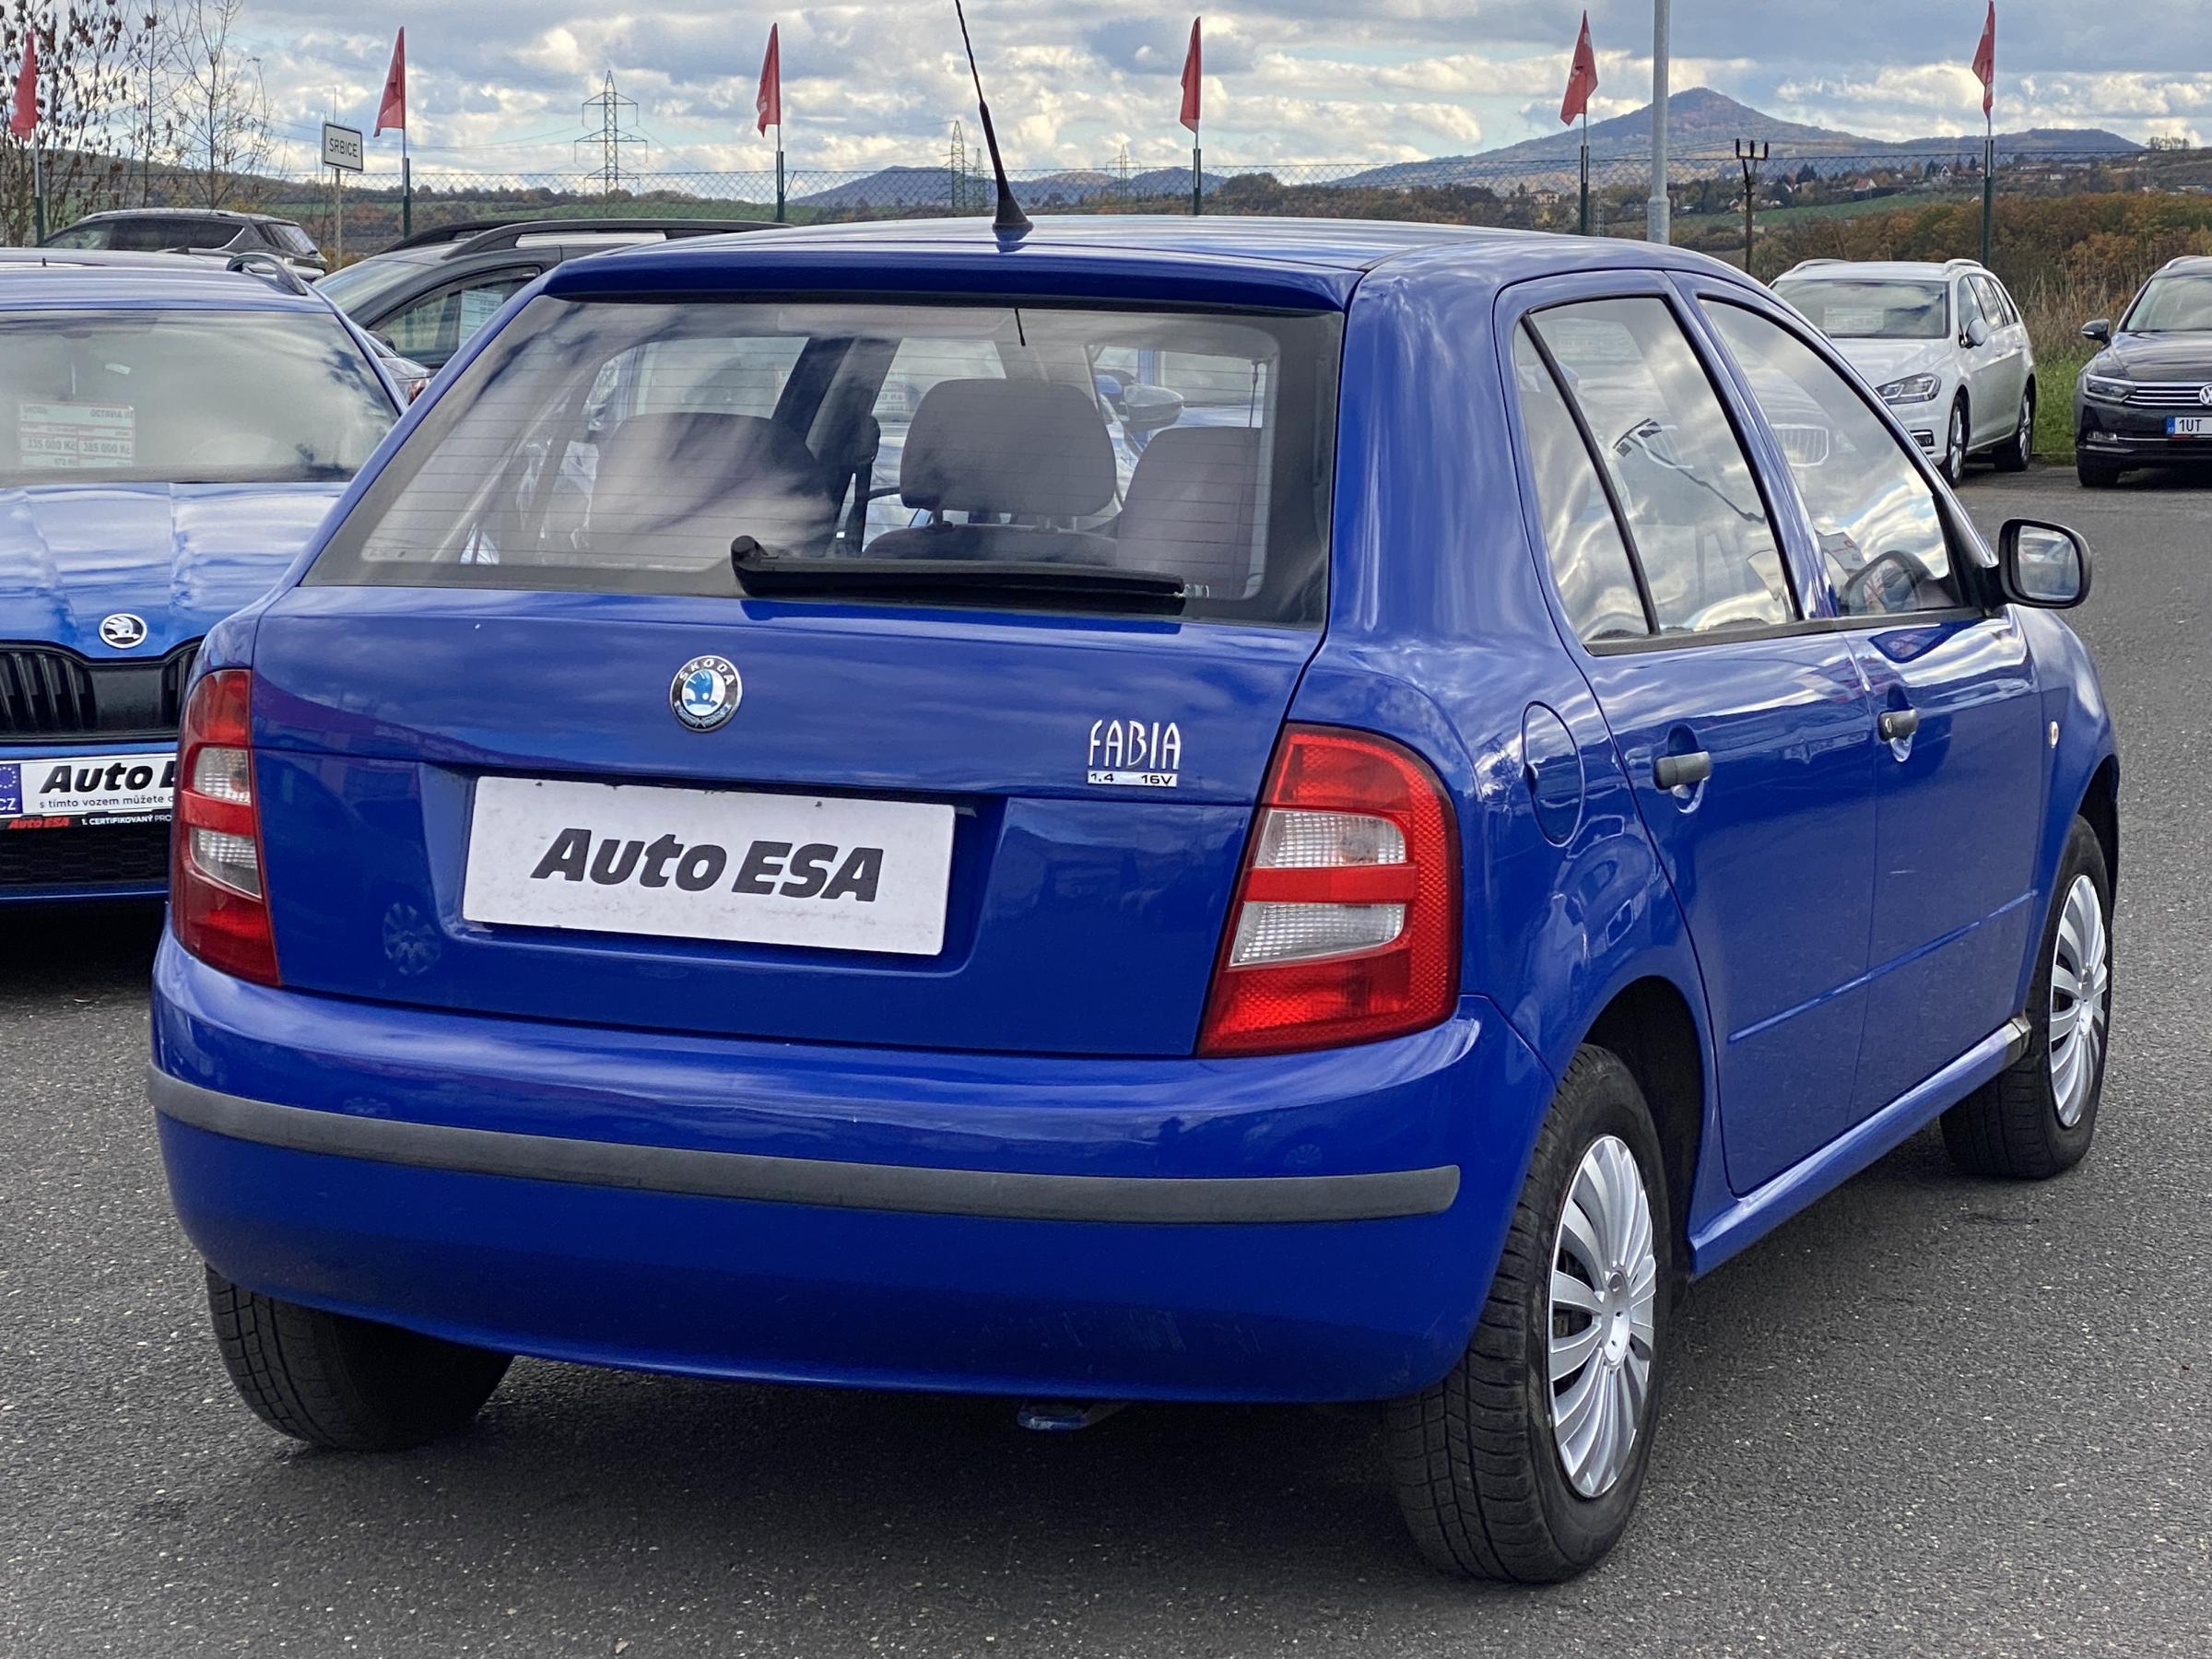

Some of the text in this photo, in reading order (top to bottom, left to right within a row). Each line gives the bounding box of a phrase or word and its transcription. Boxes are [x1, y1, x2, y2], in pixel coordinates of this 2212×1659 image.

[329, 137, 359, 158] SRBICE
[90, 408, 123, 418] OCTAVIA
[2179, 418, 2202, 431] 1UT
[1088, 719, 1181, 771] FABIA
[39, 762, 154, 794] Auto
[1090, 773, 1172, 785] 1.4 16V
[49, 798, 78, 808] tímto
[84, 797, 119, 806] vozem
[124, 794, 164, 805] můžete
[44, 817, 70, 827] ESA
[88, 814, 153, 825] CERTIFIKOVANÝ
[155, 814, 172, 822] PRO
[529, 828, 885, 902] Auto ESA
